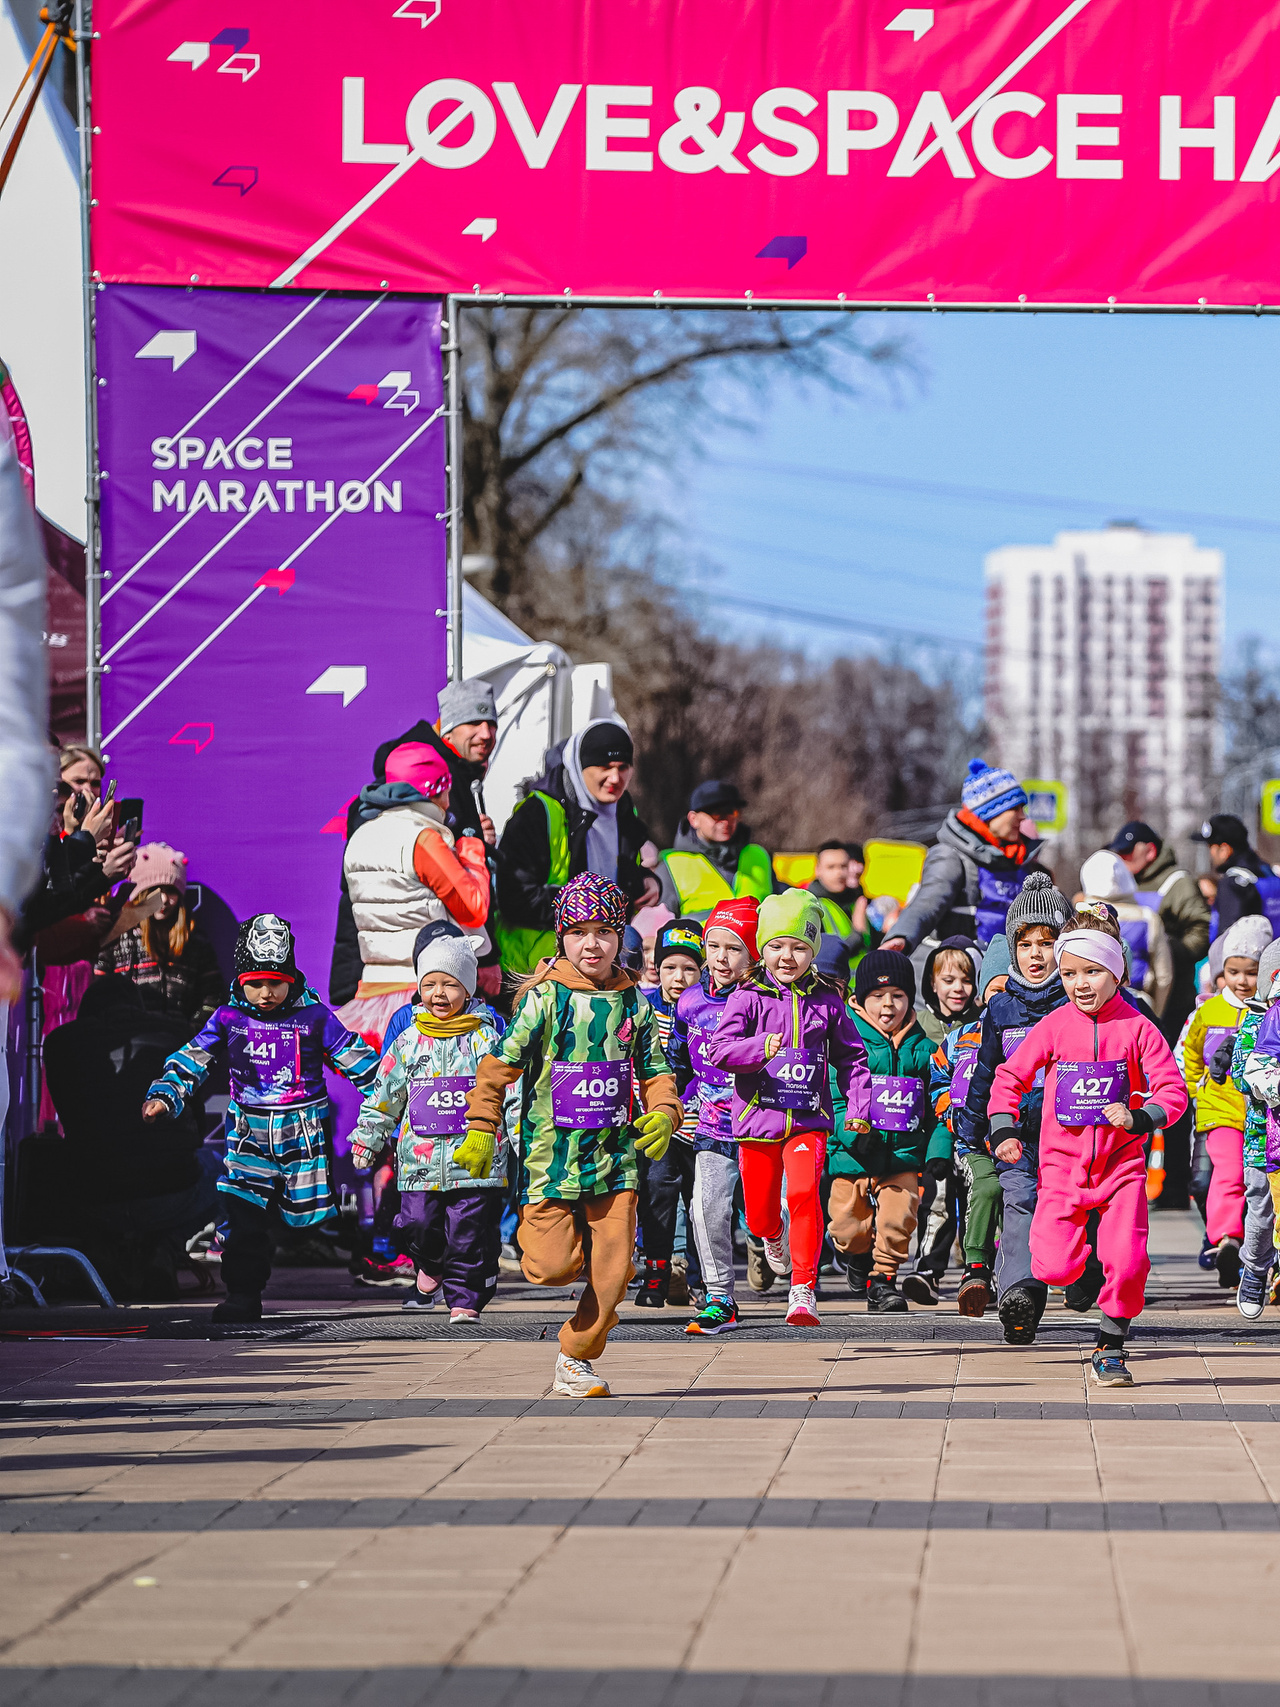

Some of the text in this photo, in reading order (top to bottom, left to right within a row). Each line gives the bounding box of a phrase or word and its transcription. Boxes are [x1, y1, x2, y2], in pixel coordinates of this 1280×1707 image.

[151, 436, 294, 471] SPACE
[243, 1041, 276, 1059] 441
[776, 1063, 816, 1082] 407
[572, 1077, 619, 1098] 408
[1071, 1077, 1114, 1096] 427
[426, 1090, 466, 1108] 433
[876, 1089, 914, 1107] 444
